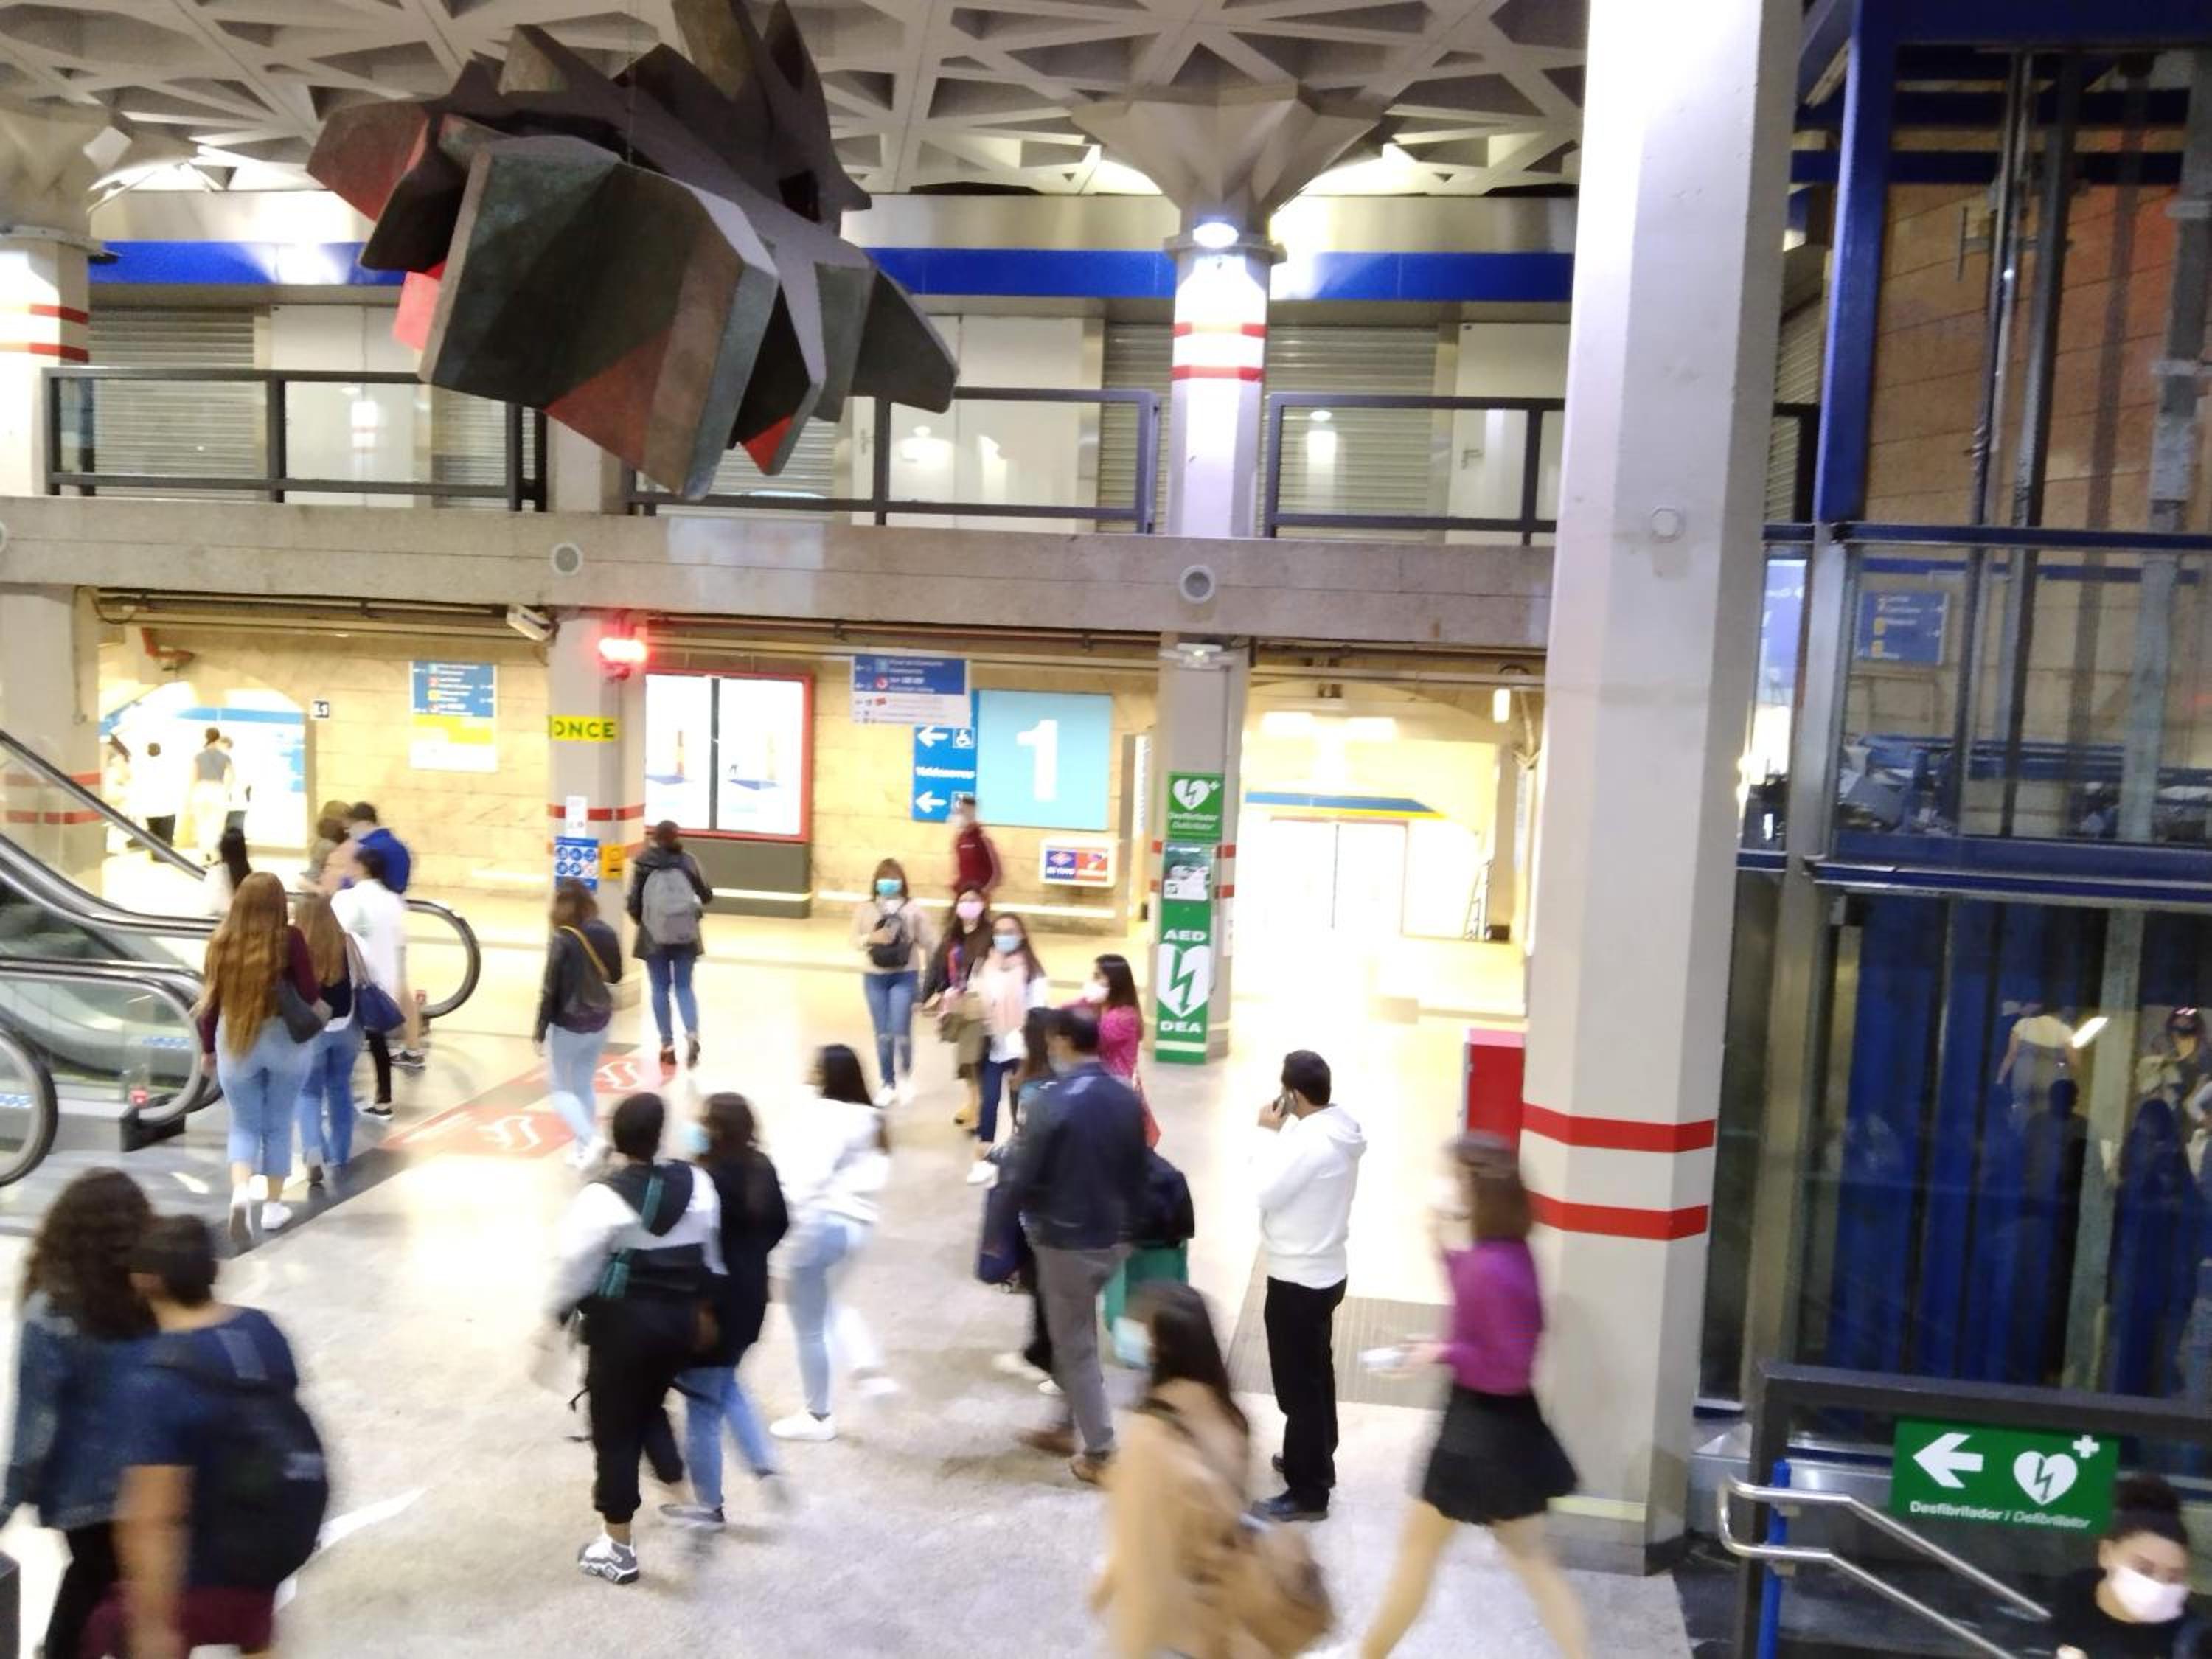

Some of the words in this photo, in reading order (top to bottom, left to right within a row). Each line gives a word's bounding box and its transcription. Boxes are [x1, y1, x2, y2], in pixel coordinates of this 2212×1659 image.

[554, 720, 614, 738] ONCE
[1016, 719, 1058, 802] 1
[1164, 928, 1207, 942] AED
[1160, 1020, 1203, 1033] DEA
[1910, 1500, 2003, 1521] Desfibrilador
